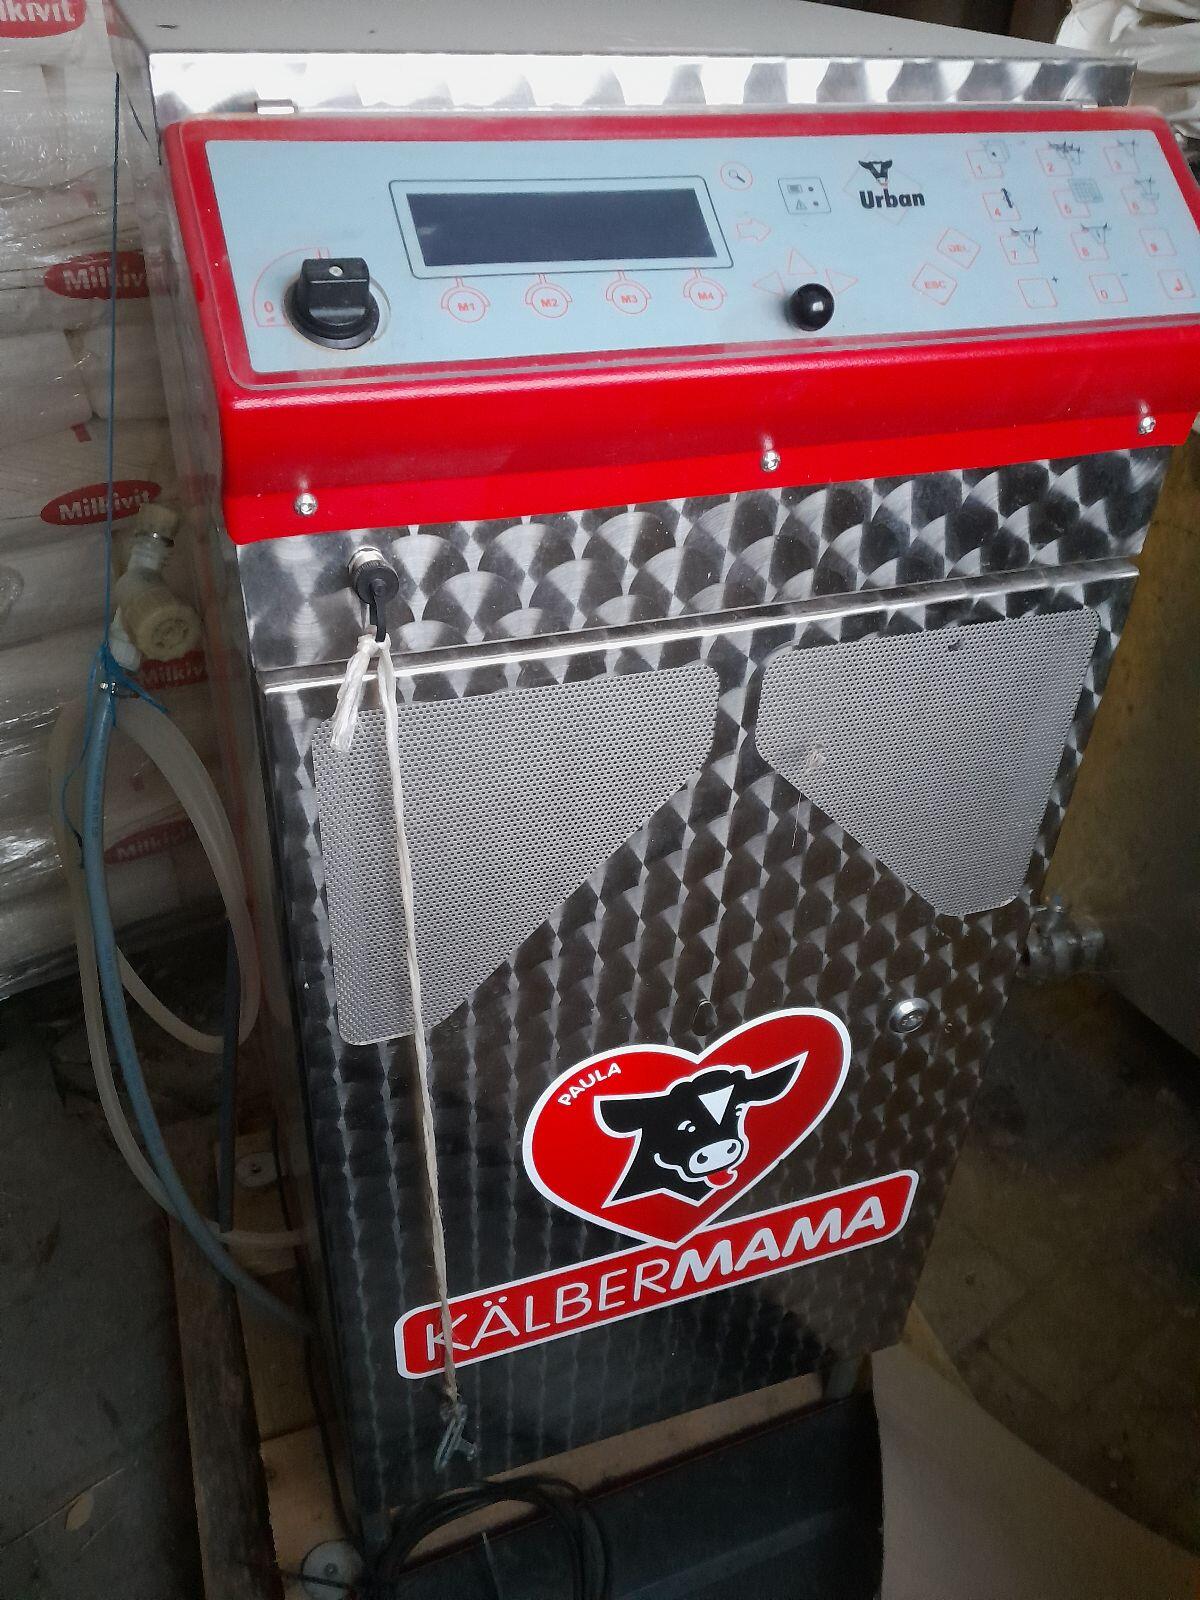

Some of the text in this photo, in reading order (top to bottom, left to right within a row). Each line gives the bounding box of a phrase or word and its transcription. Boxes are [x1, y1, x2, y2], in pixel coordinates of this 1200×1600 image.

[858, 189, 926, 210] Urban
[457, 302, 476, 312] M1
[540, 298, 559, 309] M2
[620, 294, 639, 305] M3
[557, 1062, 622, 1106] PAULA
[426, 1195, 887, 1362] KÄLBERMAMA
